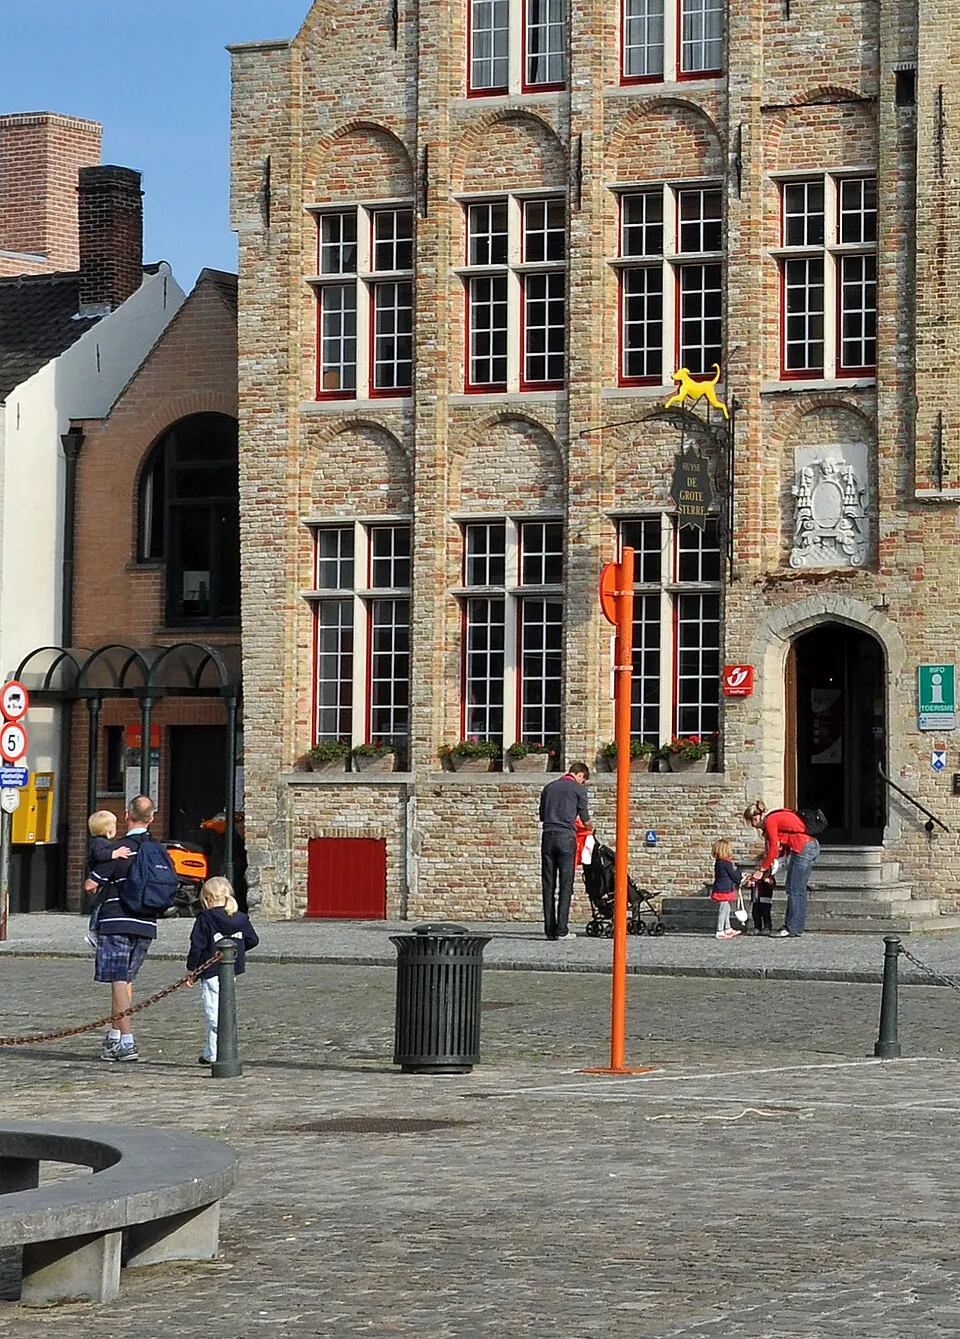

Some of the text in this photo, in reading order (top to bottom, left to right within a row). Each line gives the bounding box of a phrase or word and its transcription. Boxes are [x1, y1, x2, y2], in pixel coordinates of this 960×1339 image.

[687, 476, 698, 488] DE
[680, 490, 703, 502] GROTE
[679, 504, 706, 515] STERRE
[929, 666, 946, 674] INFO
[921, 704, 954, 712] TOERISME
[7, 734, 16, 752] 5
